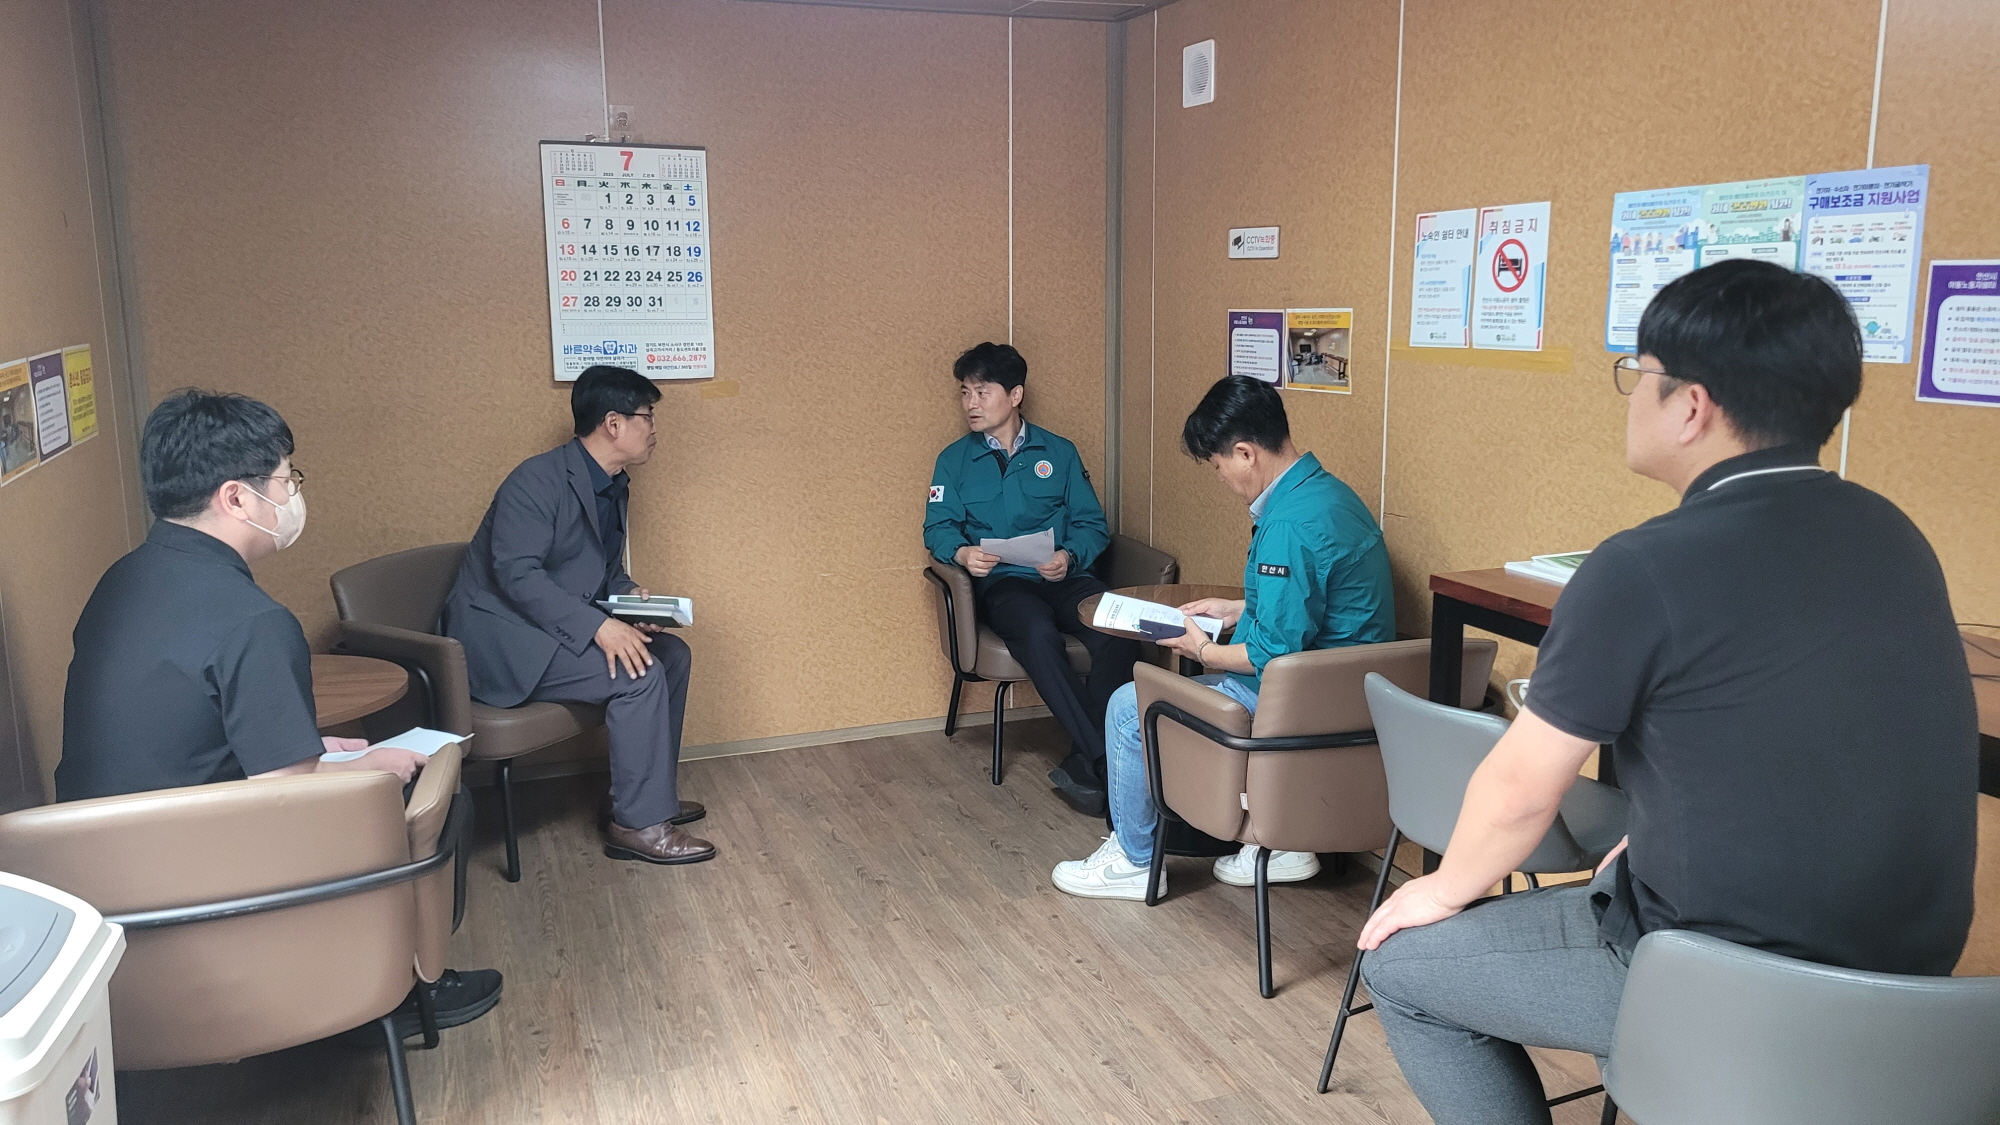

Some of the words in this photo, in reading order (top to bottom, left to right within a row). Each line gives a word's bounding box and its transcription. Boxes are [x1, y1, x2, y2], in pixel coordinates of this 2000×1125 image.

[620, 151, 633, 170] 7
[605, 193, 611, 203] 1
[626, 194, 633, 204] 2
[647, 194, 654, 205] 3
[667, 195, 675, 205] 4
[688, 195, 696, 206] 5
[1808, 193, 1864, 210] 구매보조금
[1868, 189, 1920, 205] 지원사업
[561, 218, 570, 229] 6
[583, 219, 591, 229] 7
[605, 219, 613, 229] 8
[626, 219, 634, 230] 9
[644, 220, 659, 231] 10
[666, 220, 679, 231] 11
[685, 221, 700, 231] 12
[1456, 228, 1468, 239] 안내
[559, 244, 575, 255] 13
[581, 245, 597, 255] 14
[603, 245, 618, 255] 15
[624, 245, 639, 256] 16
[645, 246, 660, 256] 17
[666, 246, 681, 256] 18
[686, 246, 701, 257] 19
[560, 270, 577, 281] 20
[583, 270, 598, 281] 21
[604, 270, 620, 281] 22
[625, 271, 641, 281] 23
[646, 271, 662, 281] 24
[667, 271, 682, 282] 25
[687, 271, 702, 282] 26
[562, 296, 578, 307] 27
[584, 296, 599, 307] 28
[605, 296, 621, 307] 29
[626, 296, 642, 307] 30
[648, 296, 662, 306] 31
[563, 344, 602, 354] 바른약속
[618, 344, 637, 353] 치과
[1262, 565, 1284, 575] 안산시
